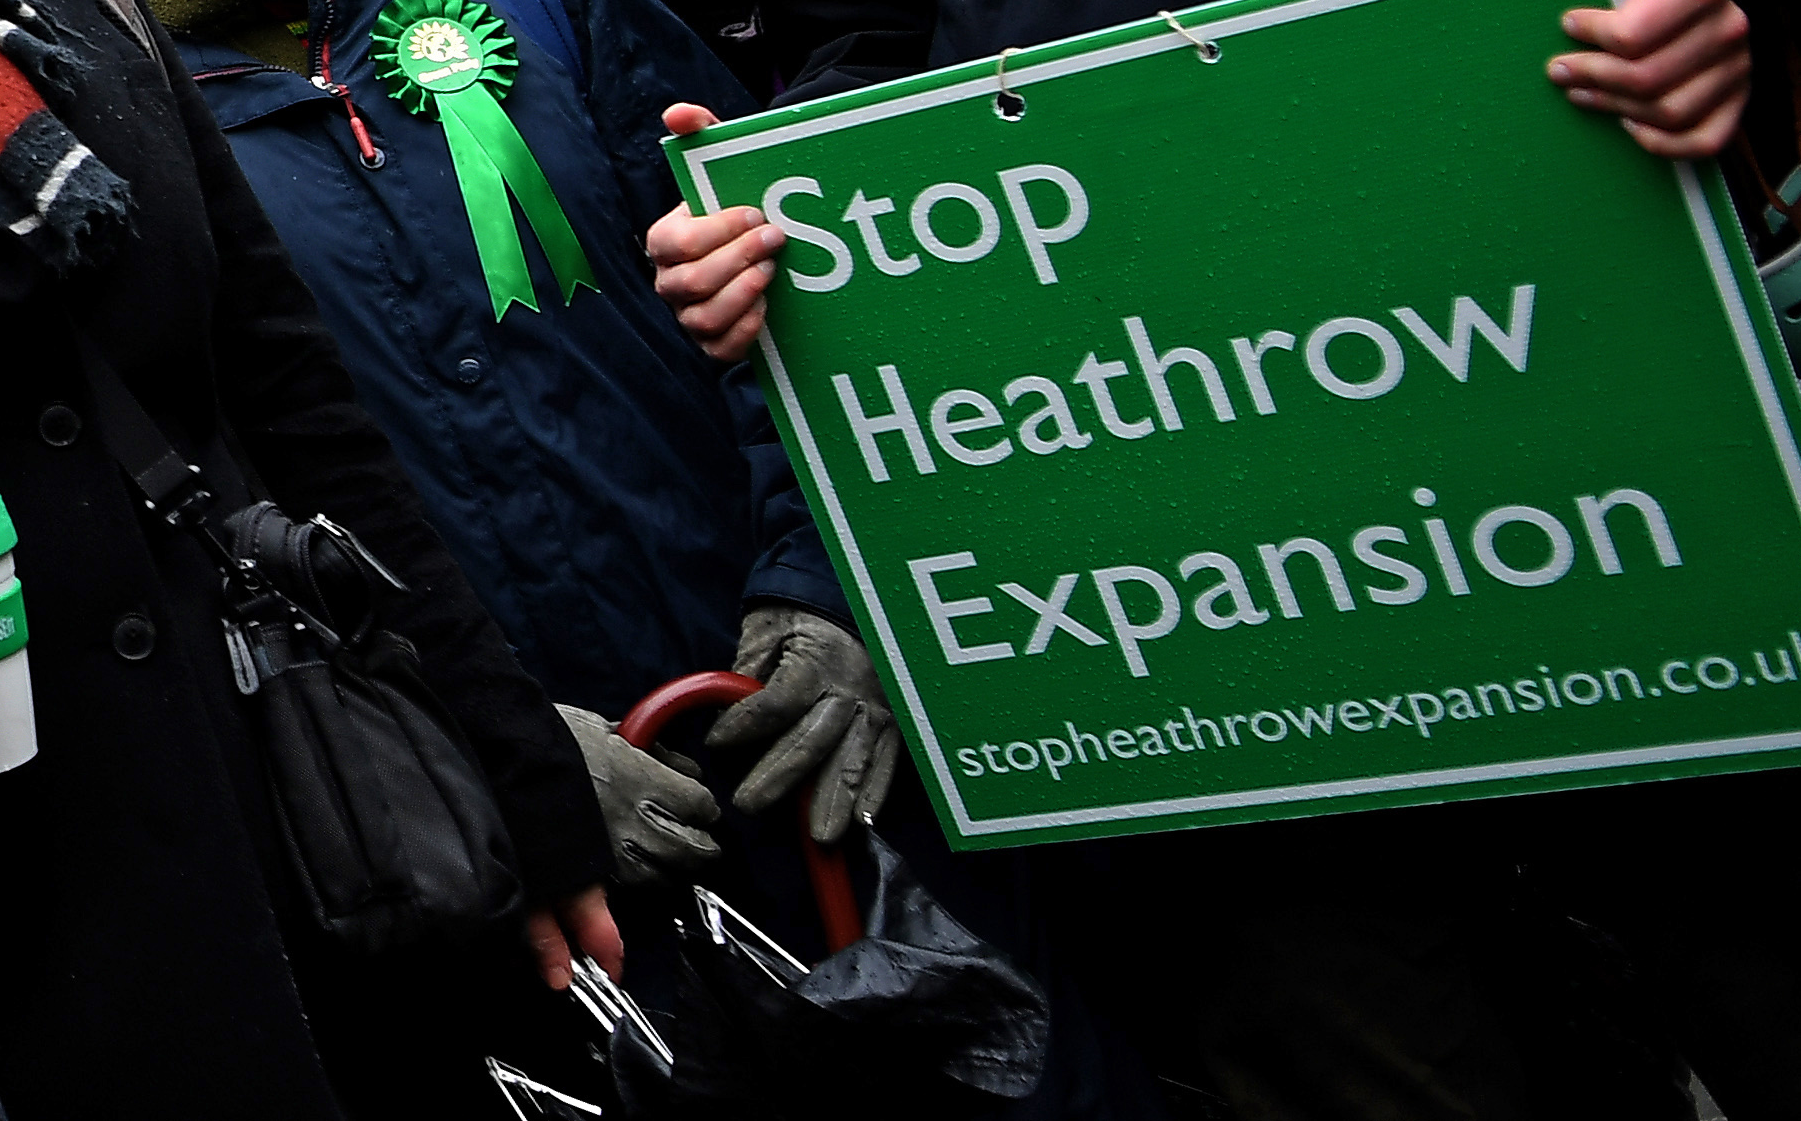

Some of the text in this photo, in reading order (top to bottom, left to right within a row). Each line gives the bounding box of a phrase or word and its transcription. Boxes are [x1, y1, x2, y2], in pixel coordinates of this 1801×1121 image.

[762, 164, 1090, 293] Stop
[830, 284, 1536, 483] Heathrow
[907, 488, 1683, 678] Expansion
